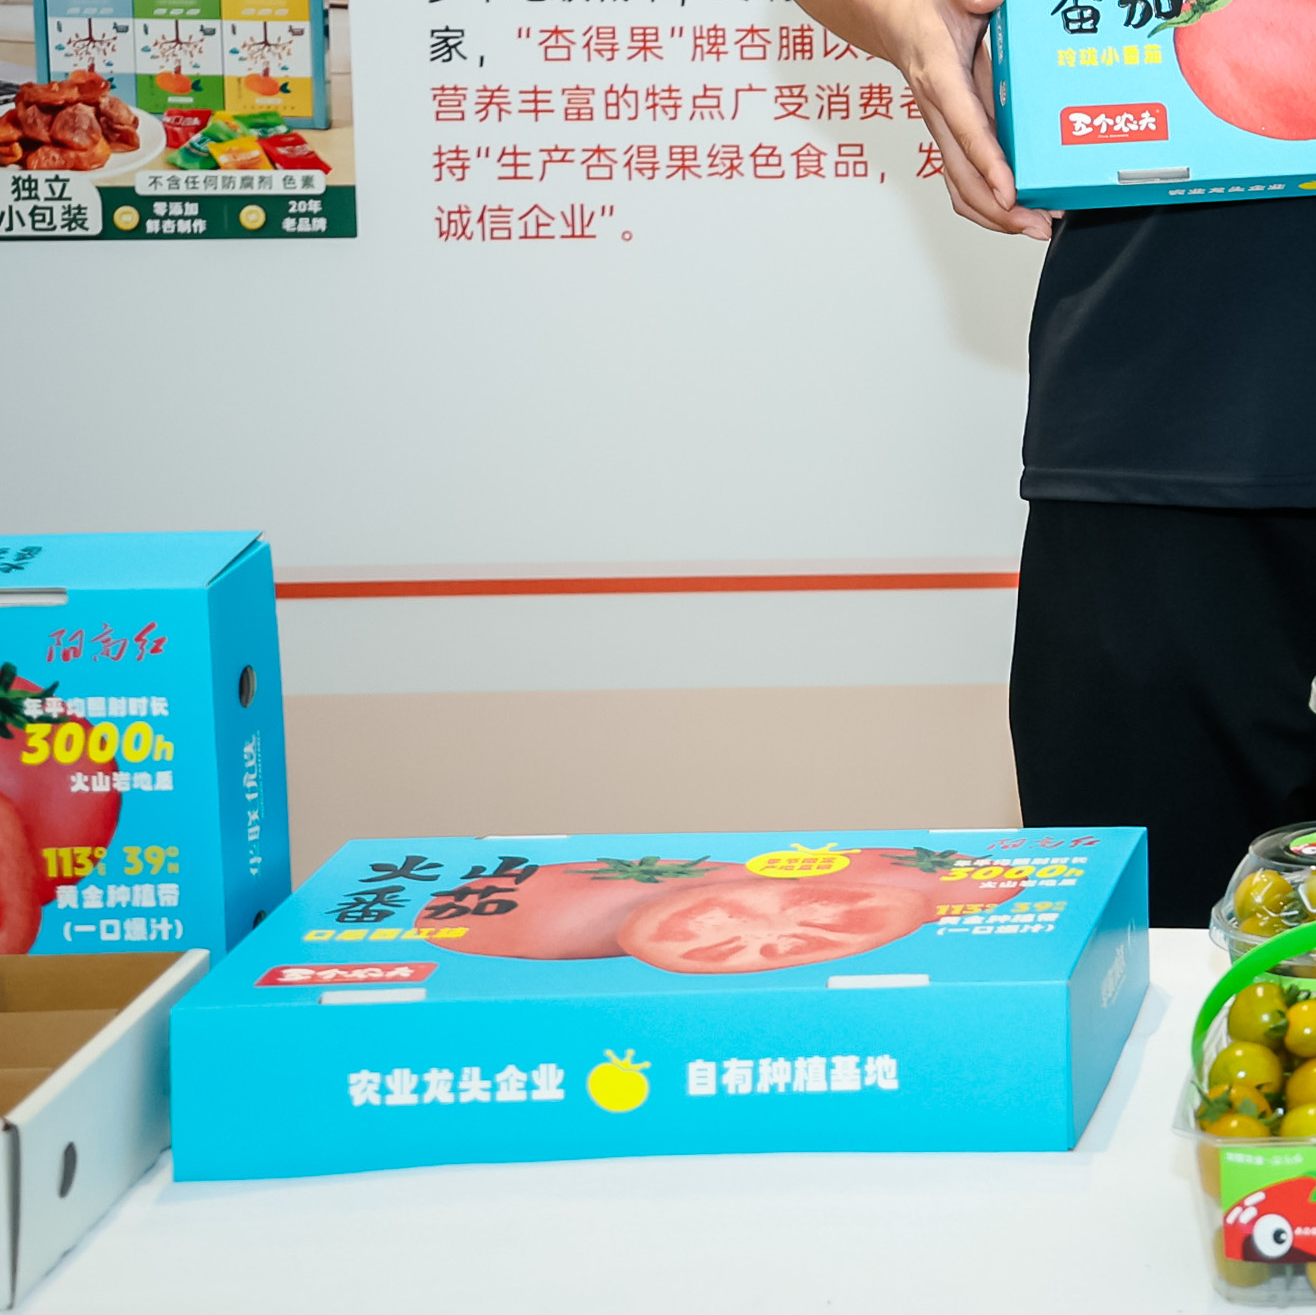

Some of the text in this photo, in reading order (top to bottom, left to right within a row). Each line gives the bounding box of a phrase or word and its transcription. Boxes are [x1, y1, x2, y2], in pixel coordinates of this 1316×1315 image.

[11, 174, 73, 203] 独立
[20, 720, 174, 766] 3000h
[348, 1063, 567, 1107] 农业龙头企业
[686, 1054, 901, 1096] 自有种植基地
